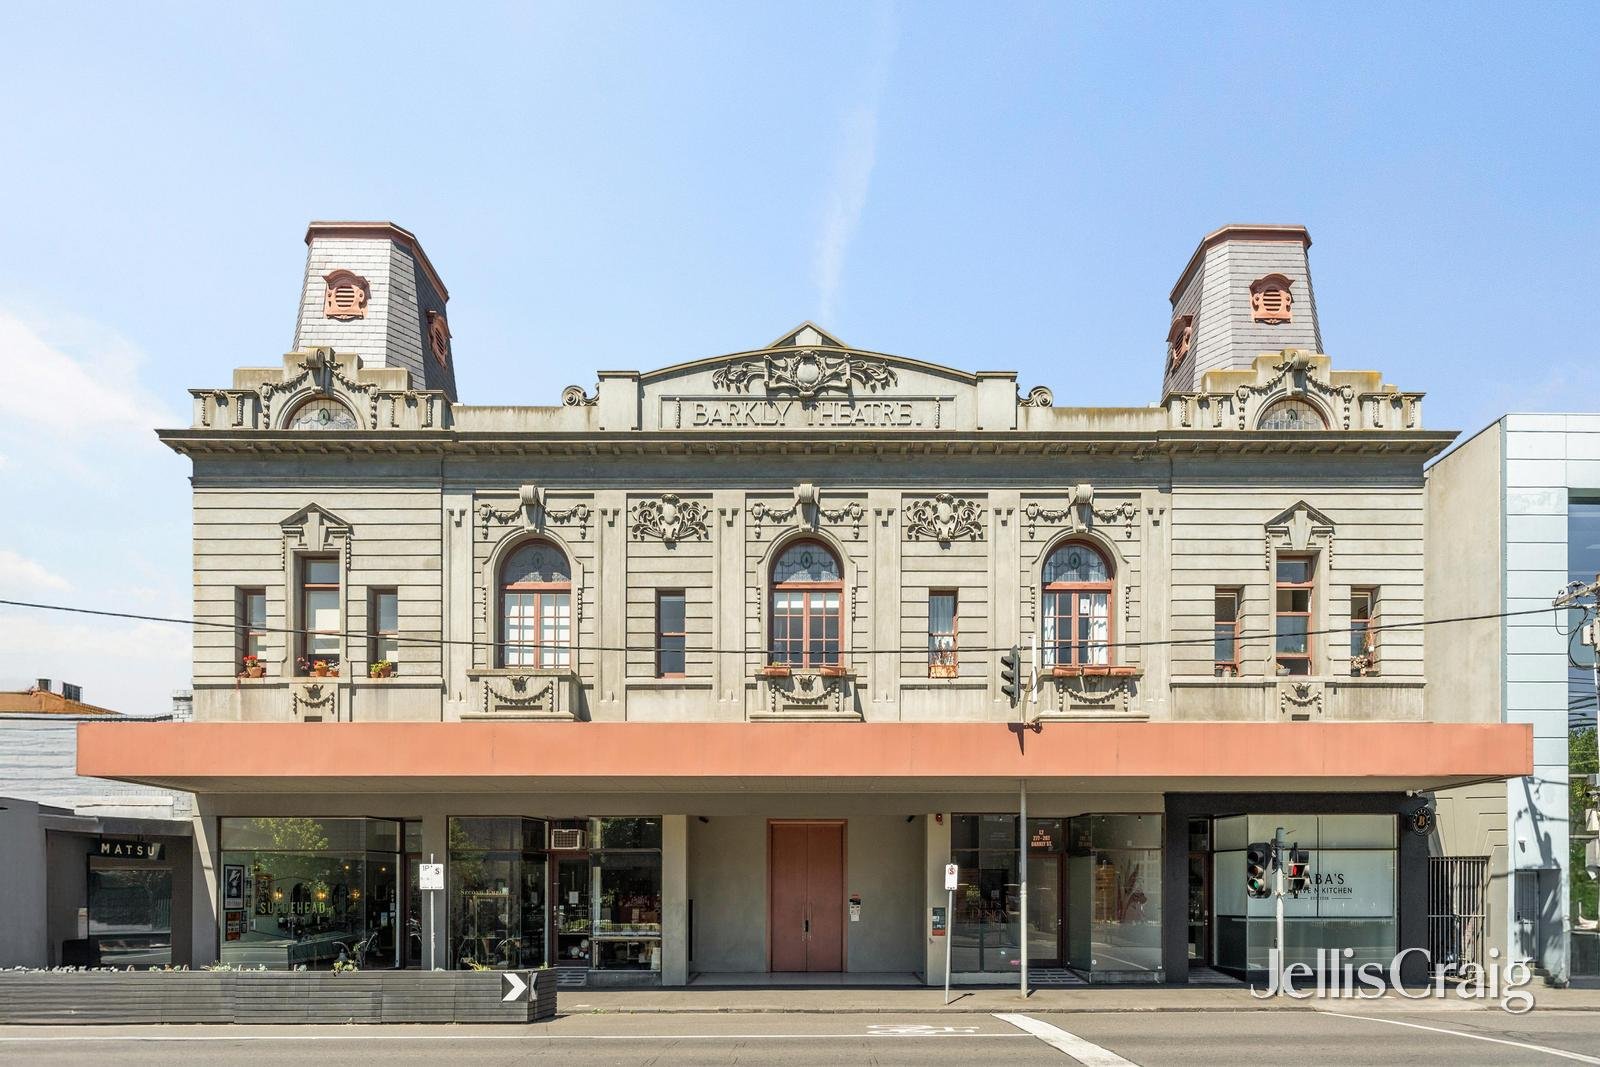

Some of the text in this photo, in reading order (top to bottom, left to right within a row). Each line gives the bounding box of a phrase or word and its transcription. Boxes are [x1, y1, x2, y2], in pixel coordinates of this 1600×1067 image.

[692, 402, 793, 426] BARKLY
[101, 843, 154, 856] MATSU
[1307, 873, 1345, 885] ABA'S
